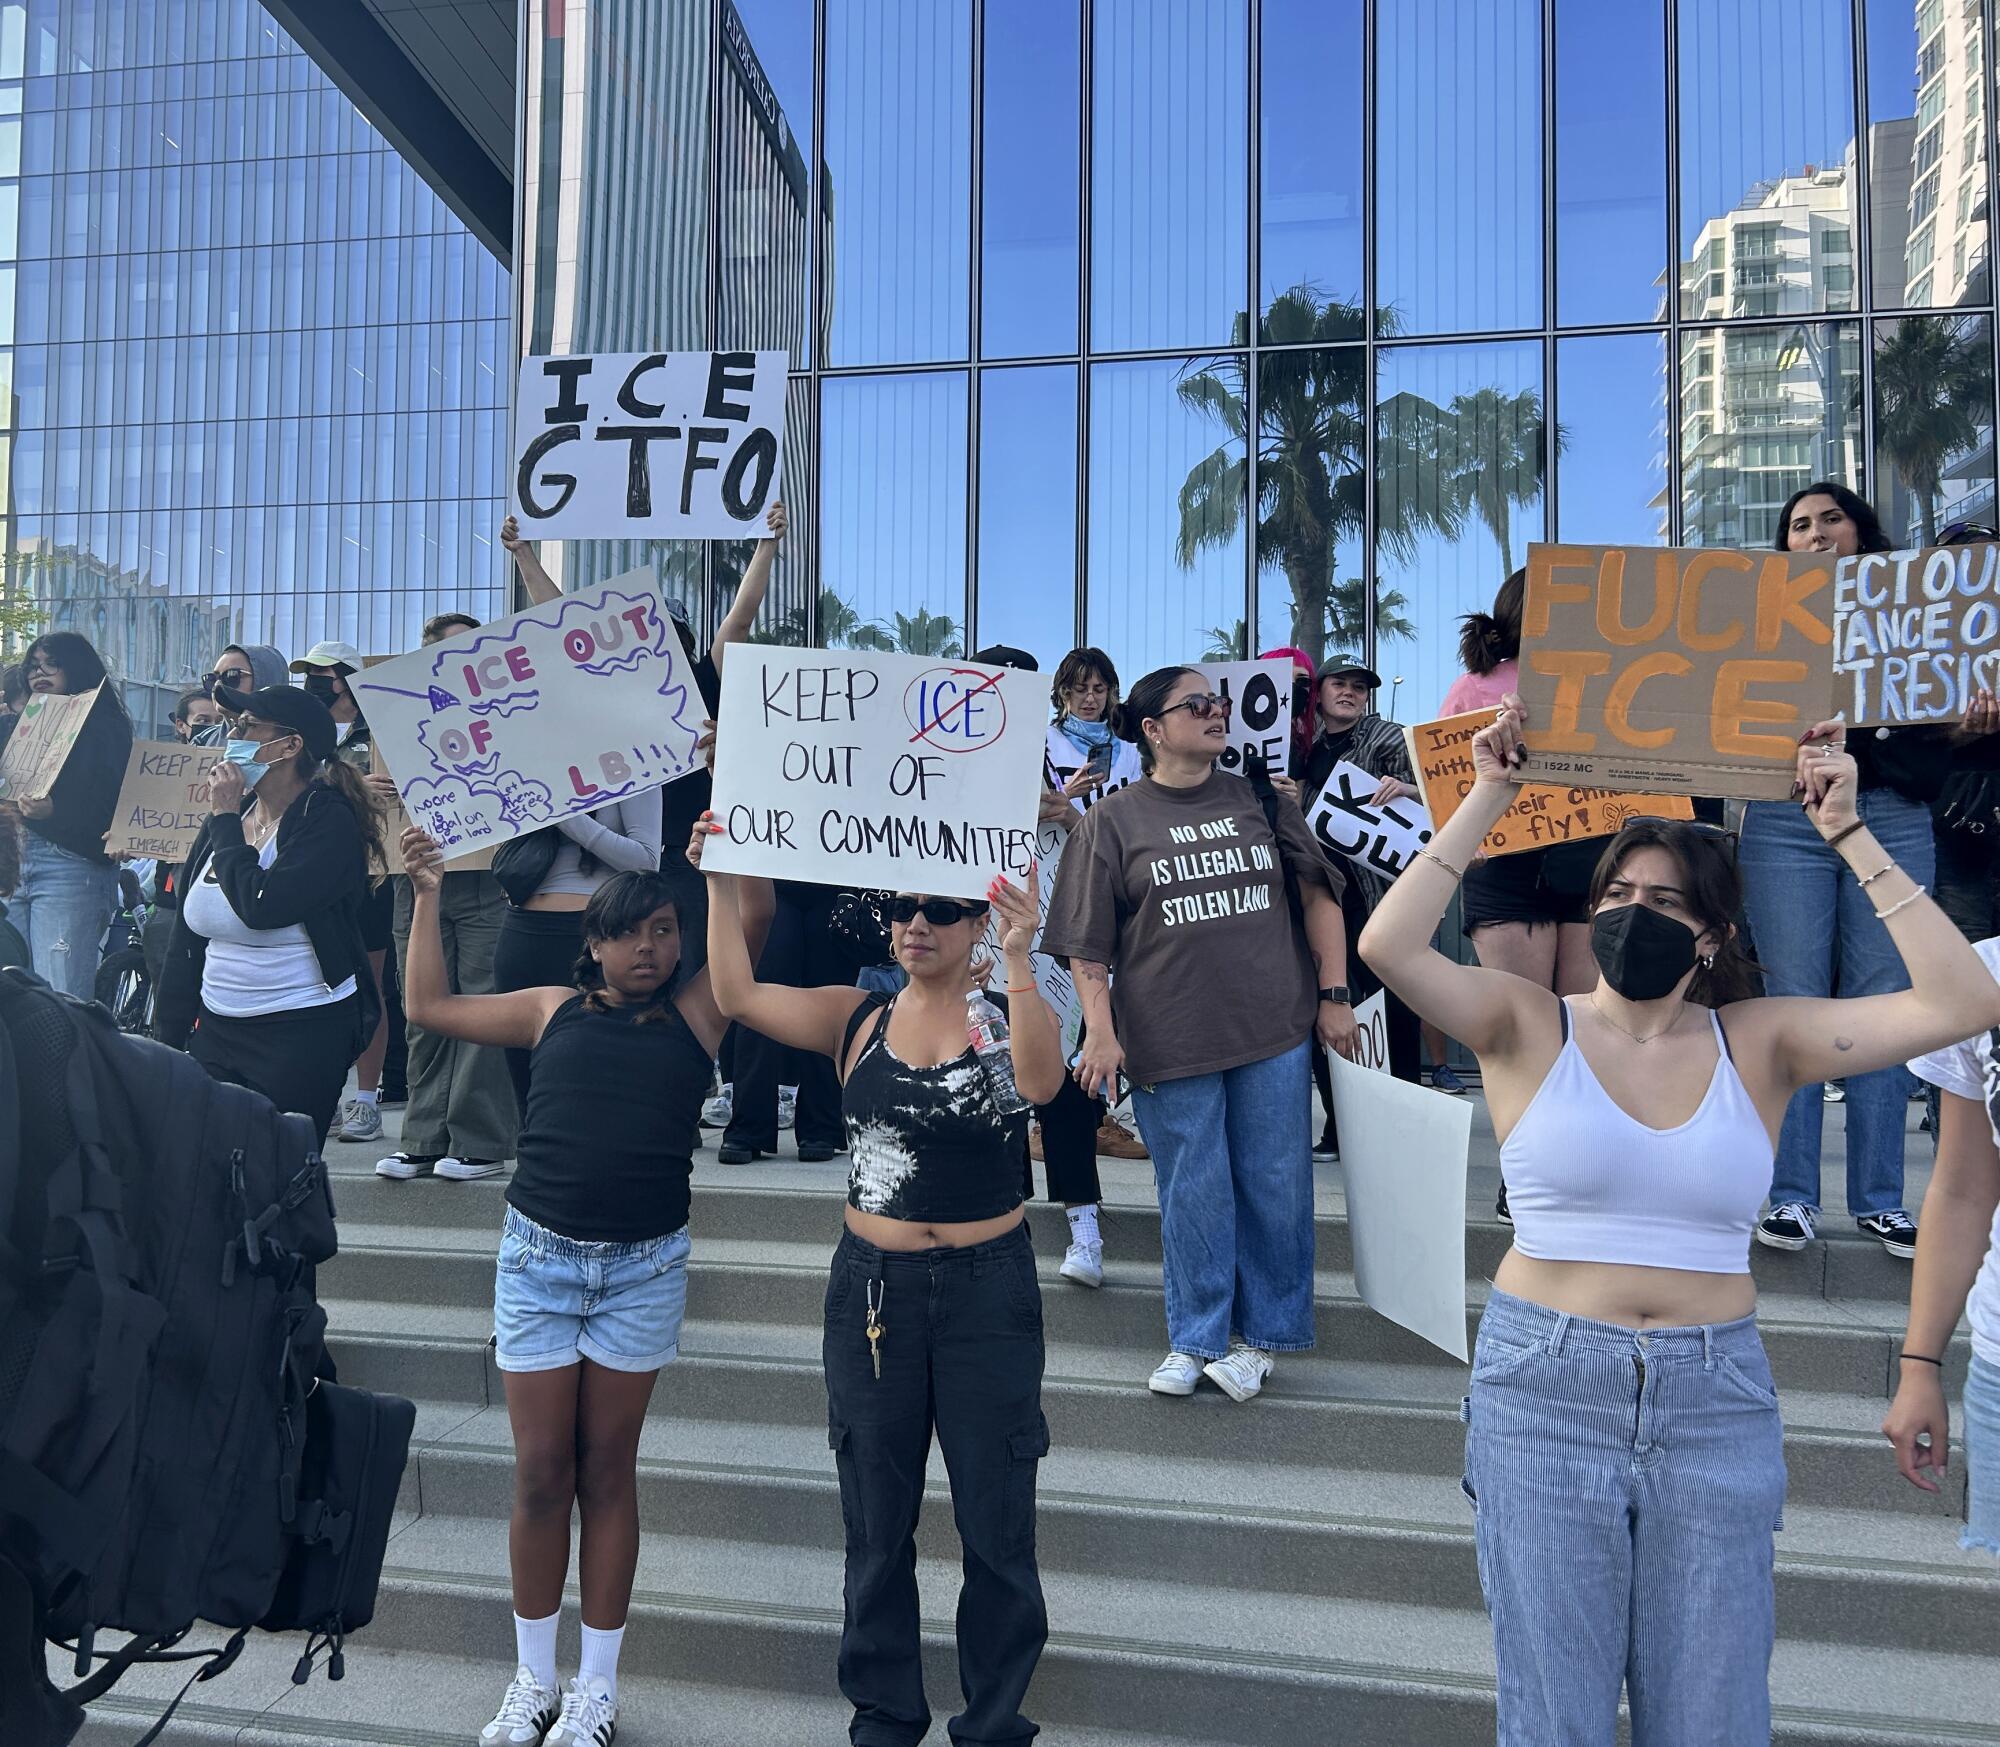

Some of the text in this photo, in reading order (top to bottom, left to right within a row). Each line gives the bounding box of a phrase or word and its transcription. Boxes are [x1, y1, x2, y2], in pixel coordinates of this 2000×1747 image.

[517, 424, 778, 521] GTFO
[1922, 544, 2000, 601] OU
[1523, 550, 1834, 652] FUCK
[463, 606, 650, 697] ICE OUT
[762, 664, 996, 737] KEEP ICE
[1524, 651, 1809, 759] ICE
[440, 720, 492, 761] OF
[1219, 736, 1285, 777] OPE
[140, 751, 192, 777] KEEP
[783, 741, 946, 800] OUT OF
[1545, 762, 1593, 773] 1522 MC
[128, 805, 206, 830] ABOLIS
[464, 810, 484, 825] on
[1315, 772, 1381, 856] CK
[1504, 792, 1554, 818] heir
[1527, 806, 1592, 841] fly!
[127, 837, 179, 853] IMPEACH
[728, 804, 798, 850] OUR
[820, 809, 1036, 877] COMMUNITIES
[1169, 817, 1239, 844] NO ONE
[1150, 844, 1273, 886] IS ILLEGAL ON
[1161, 884, 1270, 926] STOLEN LAND
